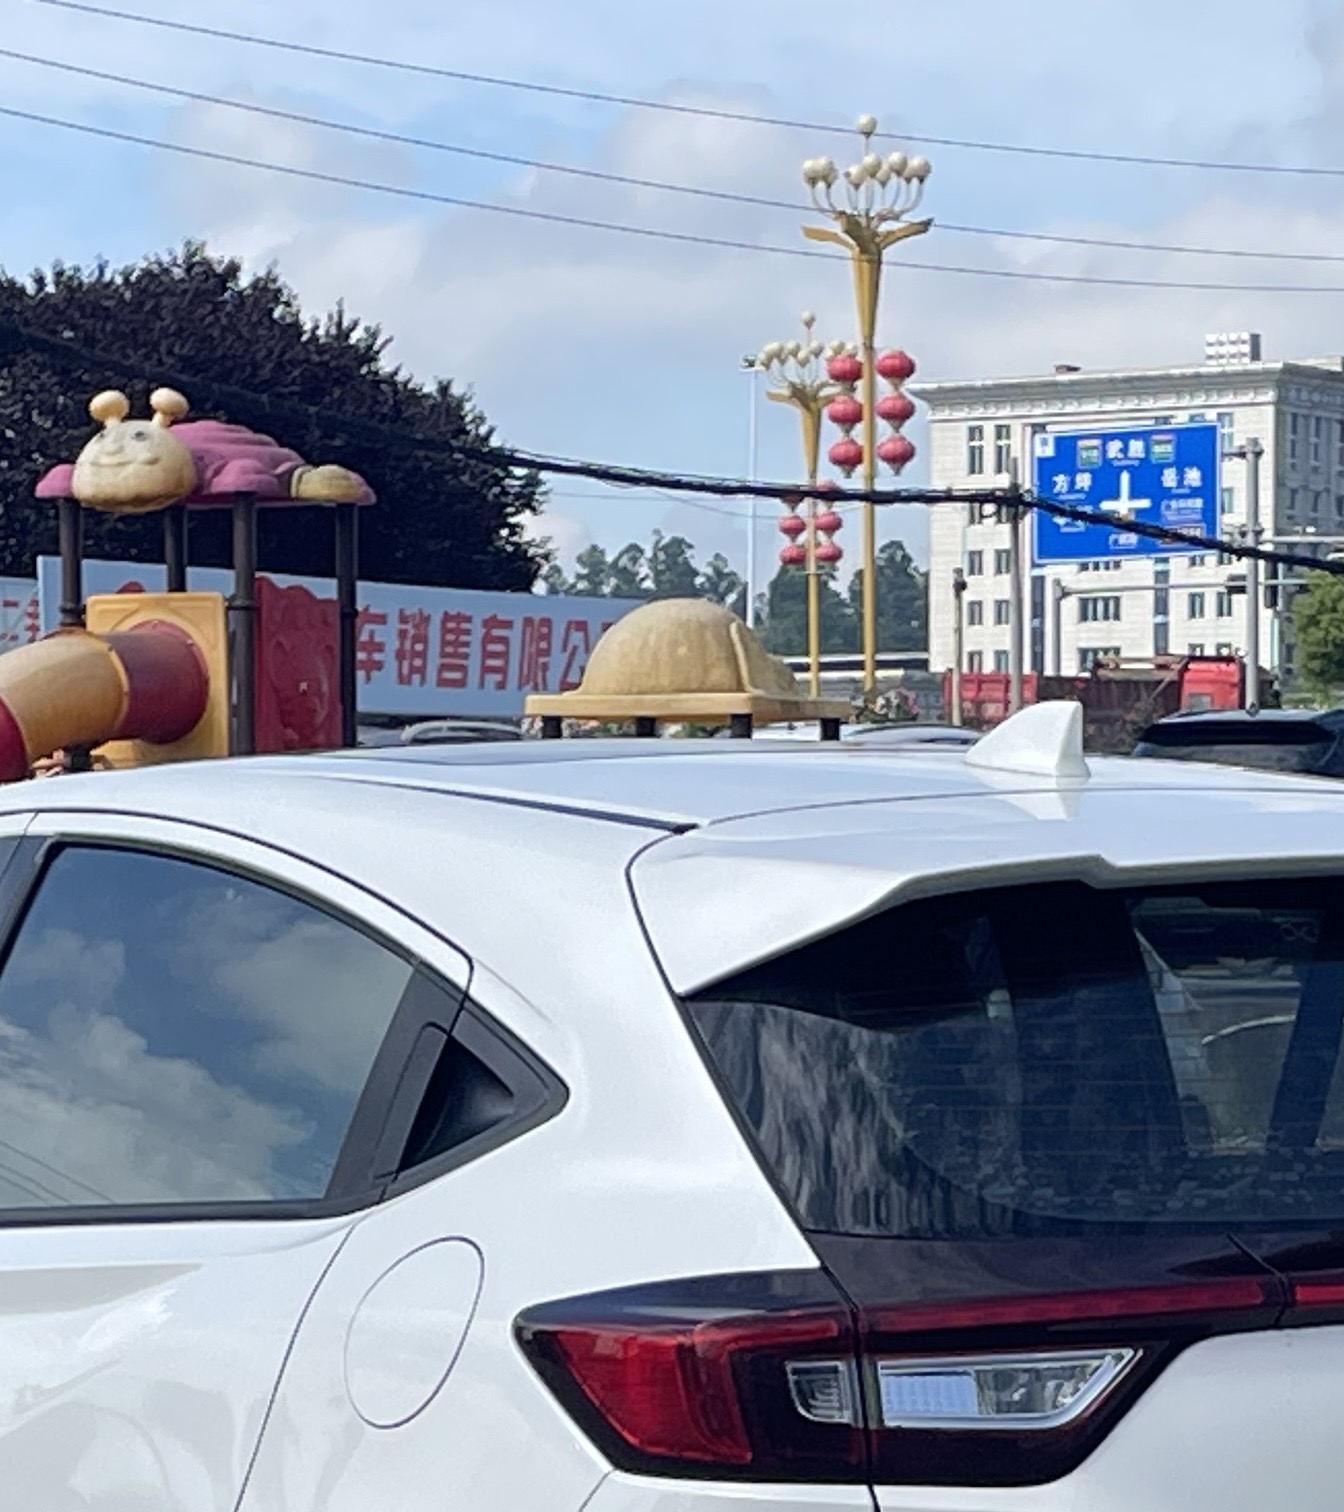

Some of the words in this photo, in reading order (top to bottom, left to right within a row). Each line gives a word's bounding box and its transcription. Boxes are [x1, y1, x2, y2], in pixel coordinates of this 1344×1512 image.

[356, 604, 618, 692] 车销售有限公
